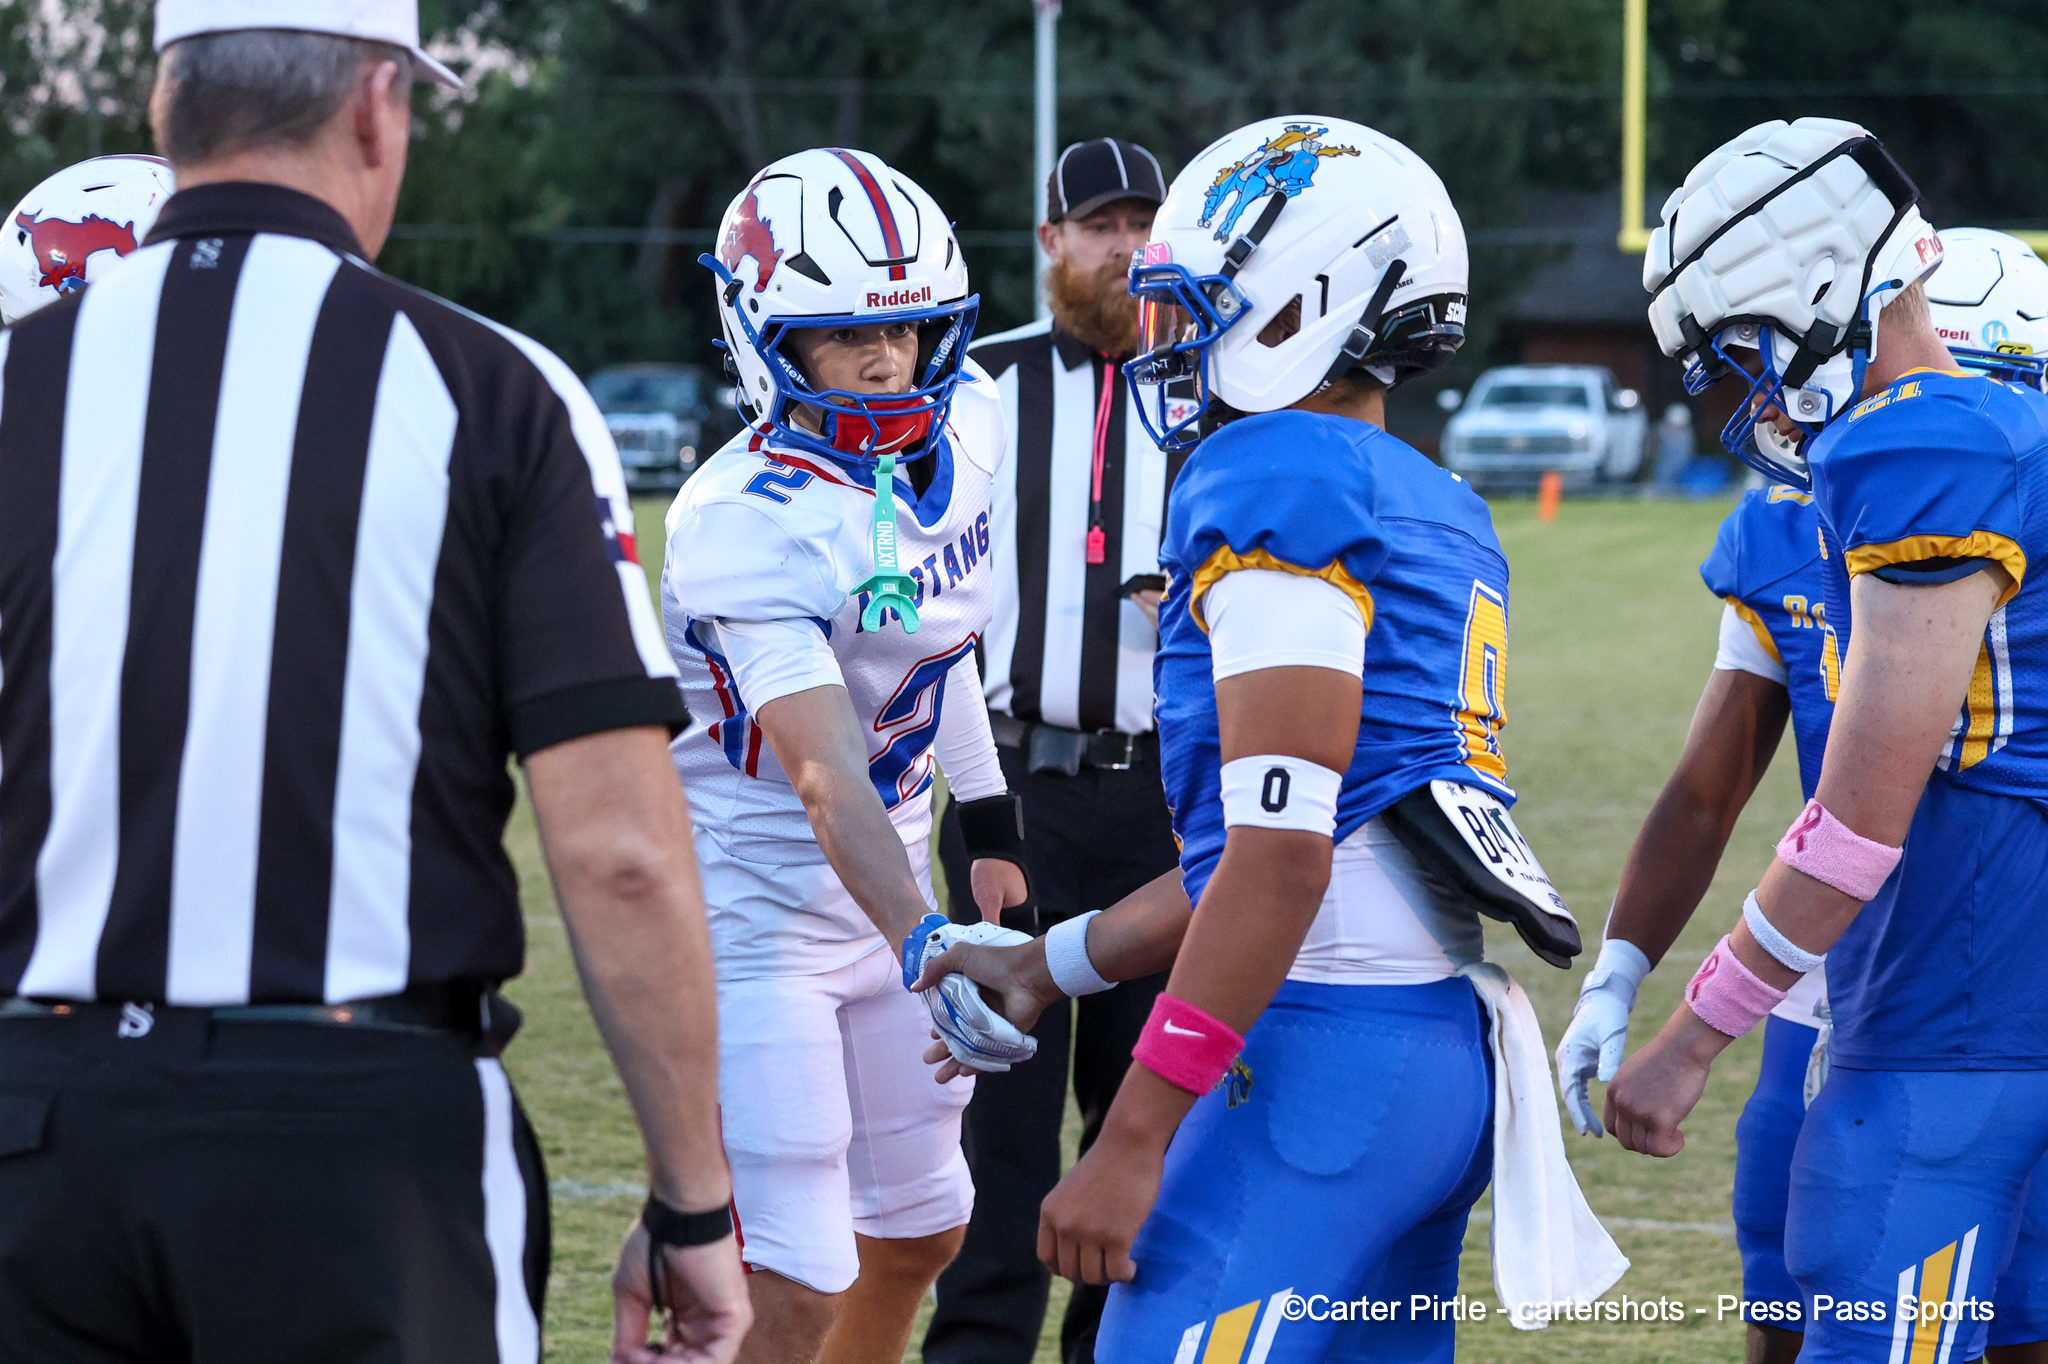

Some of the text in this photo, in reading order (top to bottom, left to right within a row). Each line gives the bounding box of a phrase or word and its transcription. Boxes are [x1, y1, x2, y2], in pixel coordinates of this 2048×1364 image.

[866, 286, 932, 308] Riddell
[742, 458, 816, 506] 2
[877, 521, 897, 567] NXTRND
[868, 631, 979, 813] 2
[1261, 768, 1291, 813] 0
